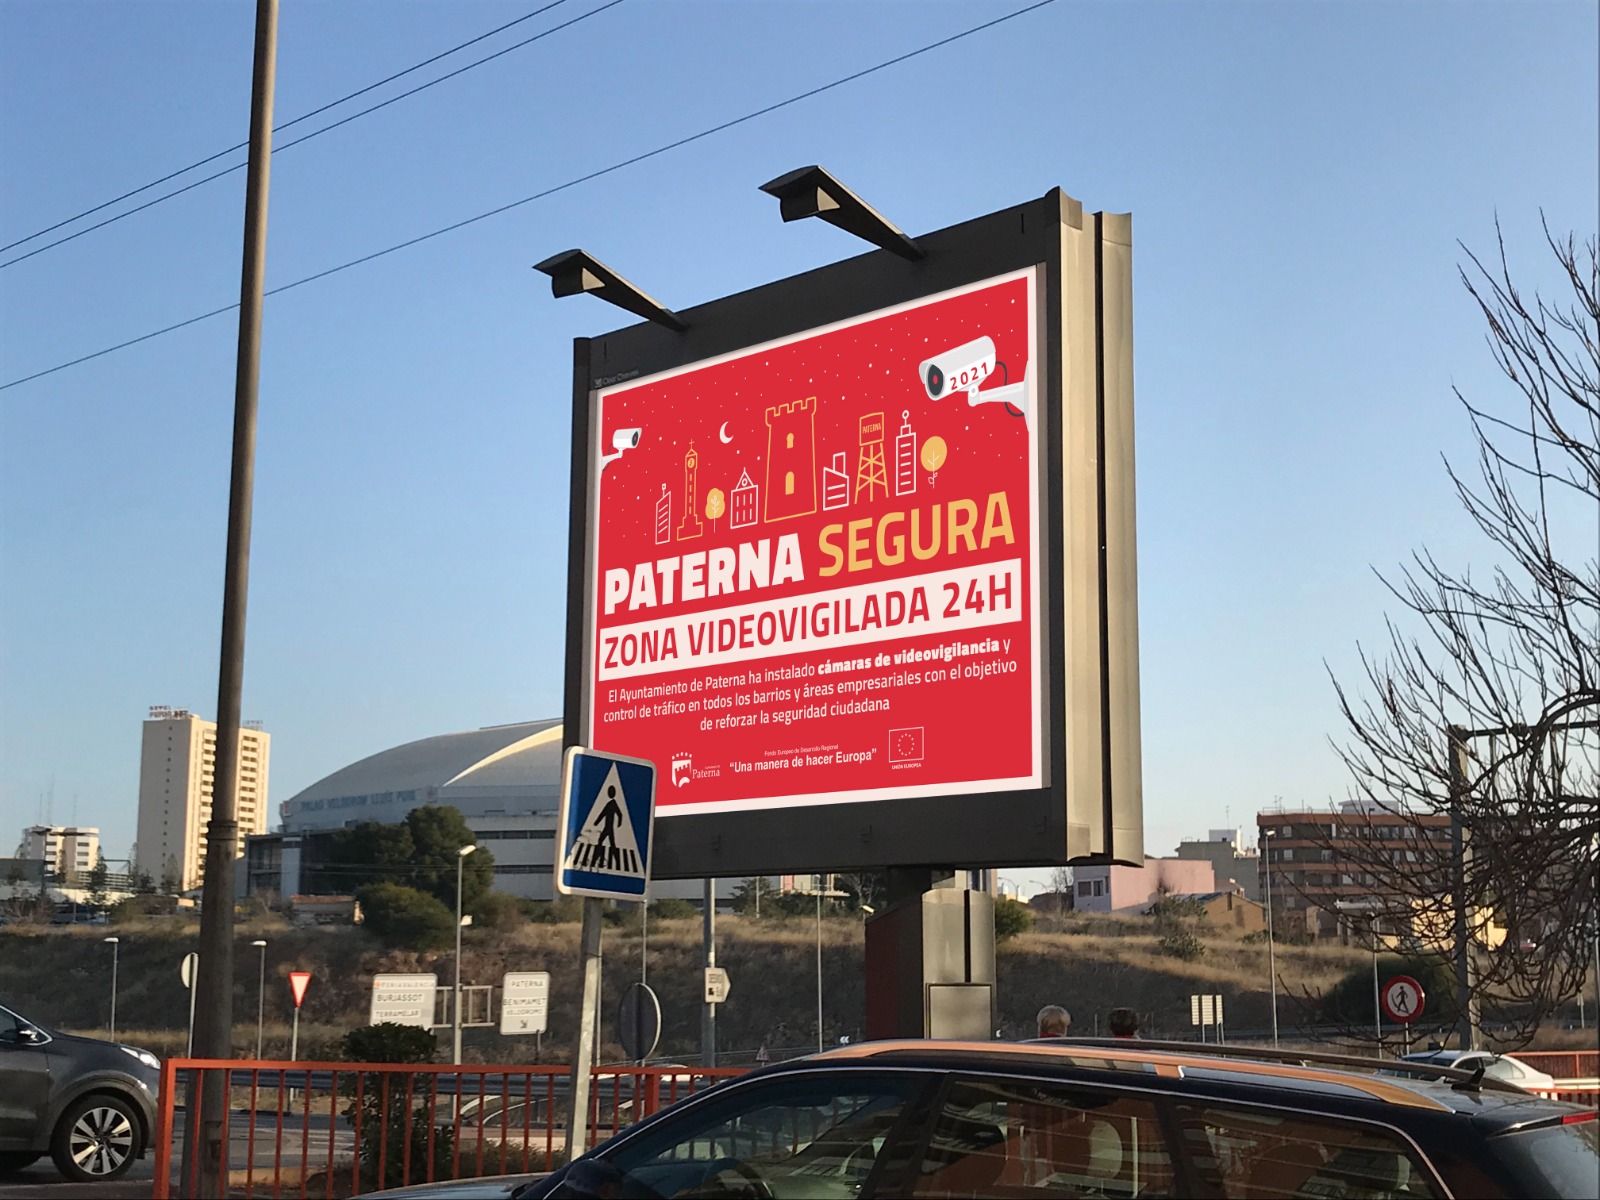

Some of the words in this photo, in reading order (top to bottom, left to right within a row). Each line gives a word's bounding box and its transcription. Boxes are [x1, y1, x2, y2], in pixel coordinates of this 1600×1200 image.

[950, 361, 988, 390] 2021
[604, 533, 805, 615] PATERNA
[818, 491, 1015, 577] SEGURA
[604, 628, 678, 669] ZONA
[688, 586, 930, 657] VIDEOVIGILADA
[943, 572, 1012, 619] 24H
[608, 688, 618, 703] El
[620, 681, 688, 704] Ayuntamiento
[690, 678, 703, 692] de
[705, 674, 746, 690] Paterna
[749, 669, 762, 684] ha
[764, 662, 815, 682] instalado
[817, 656, 872, 675] cámaras
[874, 652, 891, 667] de
[894, 637, 1000, 664] videovigilancia
[1002, 638, 1011, 654] y
[603, 706, 637, 722] control
[639, 703, 651, 718] de
[653, 700, 686, 717] tráfico
[688, 700, 701, 712] en
[703, 694, 733, 710] todos
[735, 691, 751, 706] los
[753, 687, 791, 704] barrios
[793, 687, 801, 702] y
[803, 683, 834, 698] áreas
[837, 671, 921, 695] empresariales
[924, 669, 947, 683] con
[949, 666, 961, 680] el
[964, 658, 1017, 680] objetivo
[700, 717, 713, 731] de
[715, 713, 757, 729] reforzar
[760, 710, 770, 724] la
[772, 701, 827, 725] seguridad
[830, 698, 890, 716] ciudadana
[692, 768, 720, 779] Paterna
[754, 757, 789, 772] manera
[791, 754, 804, 768] de
[805, 751, 833, 766] hacer
[376, 993, 423, 1002] BURJASSOT
[511, 980, 544, 988] PATERNA
